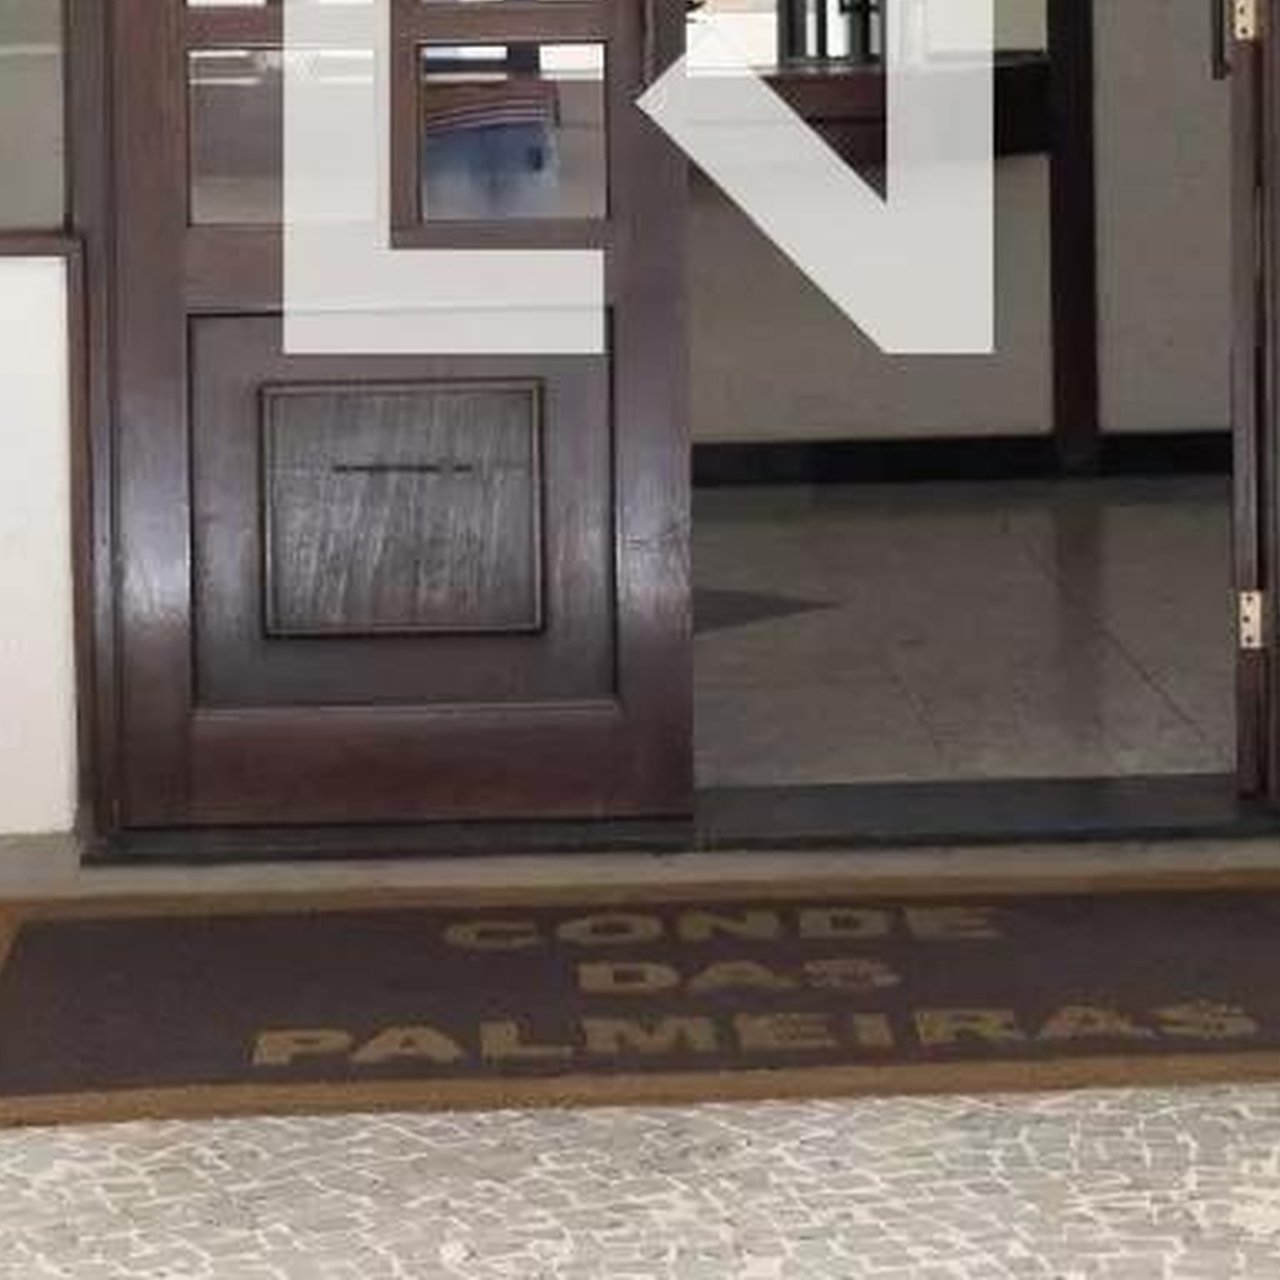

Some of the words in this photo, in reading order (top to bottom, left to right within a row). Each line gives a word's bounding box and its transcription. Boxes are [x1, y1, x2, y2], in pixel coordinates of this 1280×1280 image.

[443, 906, 1003, 949] CONDE
[577, 958, 901, 993] DAS
[251, 1000, 1259, 1067] PALMEIRAS
